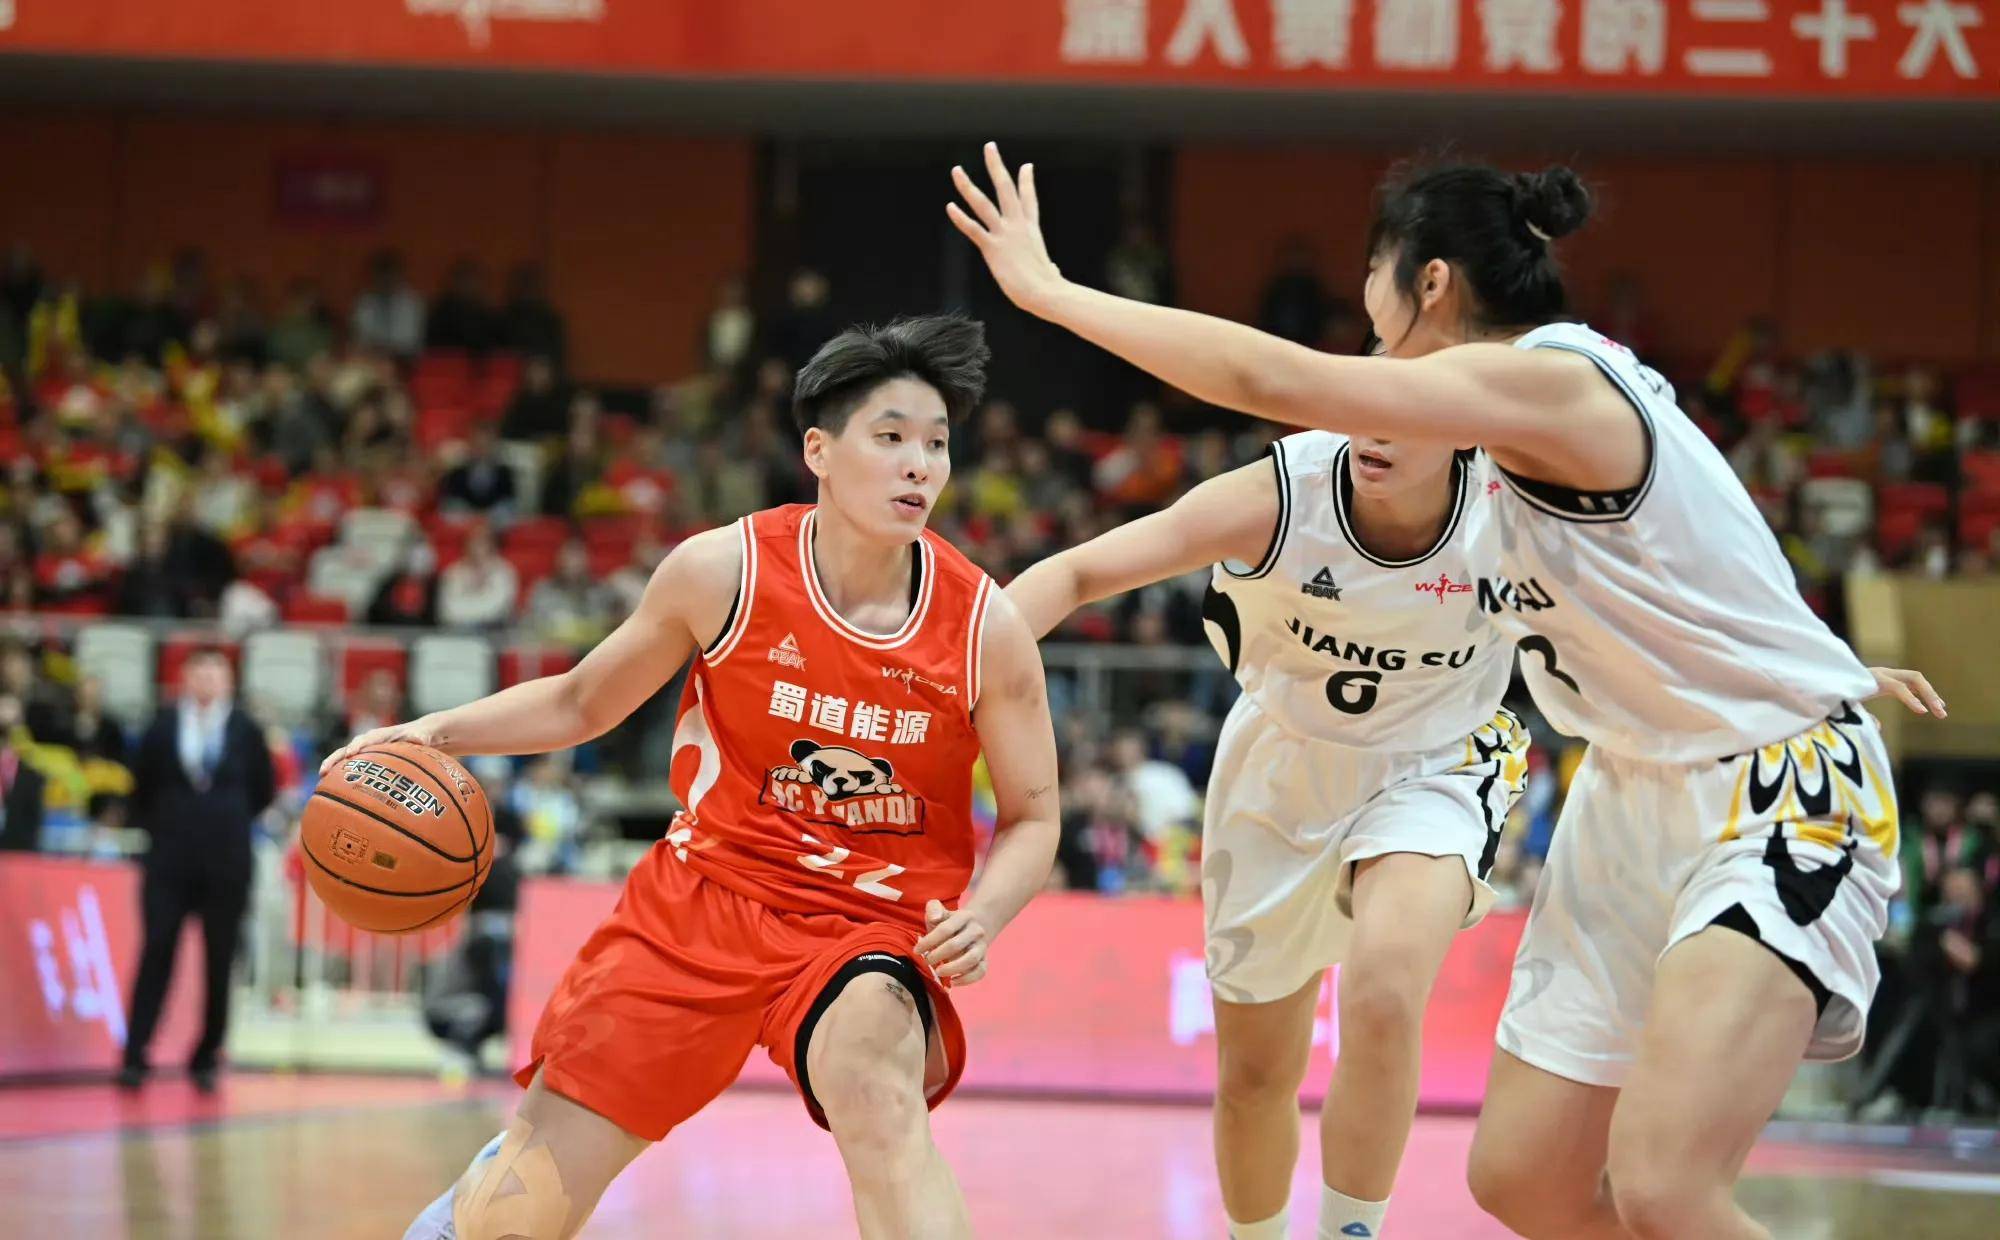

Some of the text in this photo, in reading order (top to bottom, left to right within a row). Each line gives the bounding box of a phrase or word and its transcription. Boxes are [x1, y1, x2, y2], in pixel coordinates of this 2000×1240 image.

[1302, 583, 1341, 601] PEAK
[767, 647, 807, 672] PEAK
[1285, 617, 1407, 671] JIANG
[768, 680, 932, 744] 蜀道能源
[1325, 670, 1383, 715] 6
[343, 759, 446, 818] PRECISION
[362, 775, 424, 815] 1000
[771, 780, 804, 812] SC
